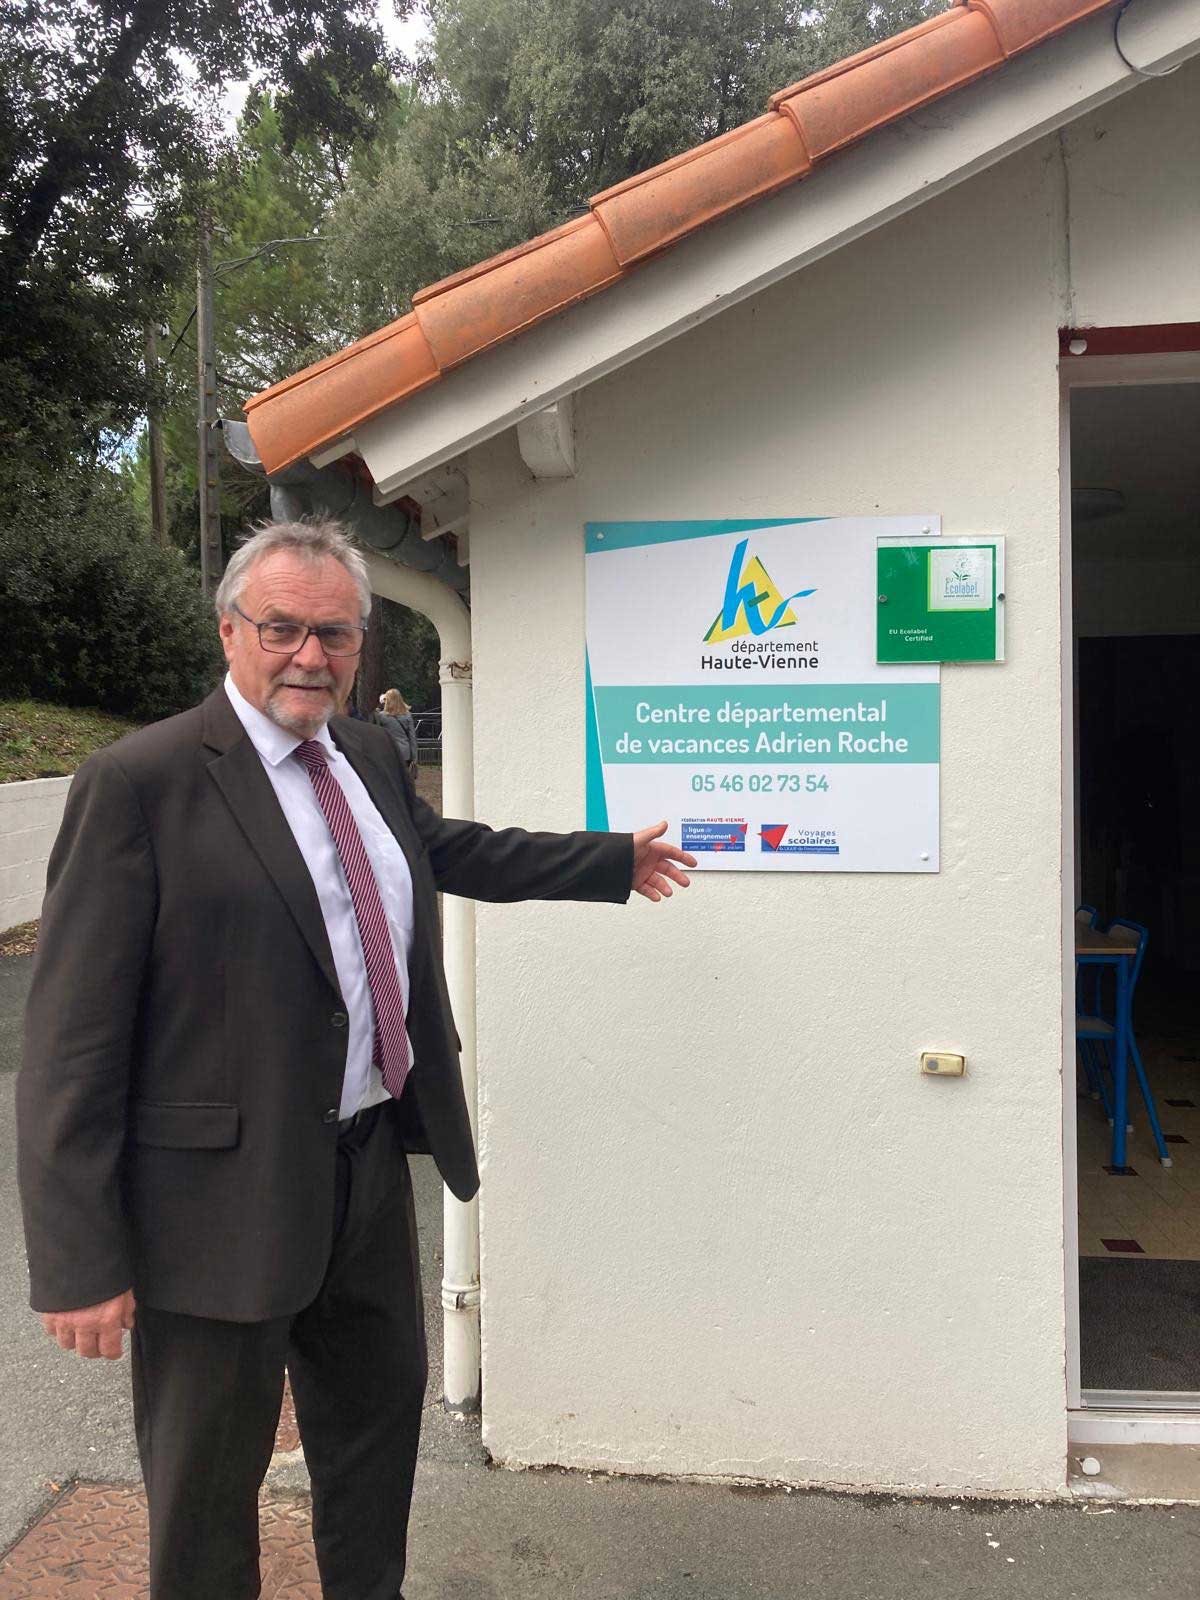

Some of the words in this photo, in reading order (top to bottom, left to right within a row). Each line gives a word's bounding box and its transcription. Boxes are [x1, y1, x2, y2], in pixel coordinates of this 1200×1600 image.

[945, 582, 978, 595] Ecolabel
[731, 640, 819, 654] département
[701, 654, 819, 670] Haute-Vienne
[636, 702, 711, 723] Centre
[717, 700, 887, 728] départemental
[615, 732, 642, 753] de
[648, 738, 750, 754] vacances
[755, 731, 831, 753] Adrien
[838, 731, 909, 753] Roche
[691, 775, 716, 792] 05
[719, 775, 744, 792] 46
[748, 775, 773, 792] 02
[777, 775, 801, 792] 73
[805, 775, 829, 792] 54
[688, 826, 705, 834] ligue
[798, 829, 836, 838] Voyages
[682, 833, 732, 841] lenseignement
[787, 837, 837, 845] scolaires
